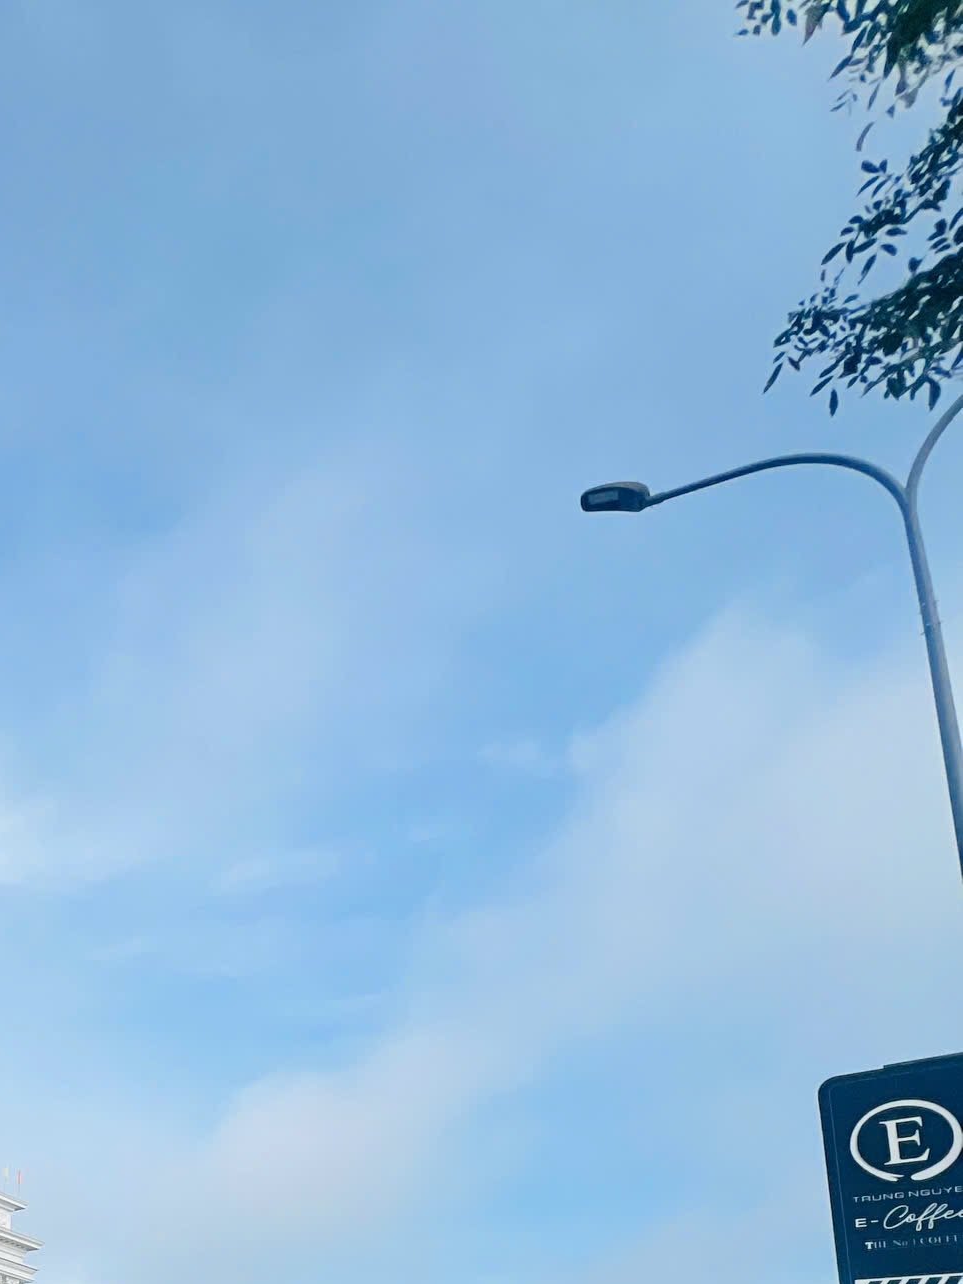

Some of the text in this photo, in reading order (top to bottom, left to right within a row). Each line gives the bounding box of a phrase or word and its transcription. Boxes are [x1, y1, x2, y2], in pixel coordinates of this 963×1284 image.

[878, 1116, 930, 1166] E
[853, 1185, 963, 1203] TRUNG NGUYE
